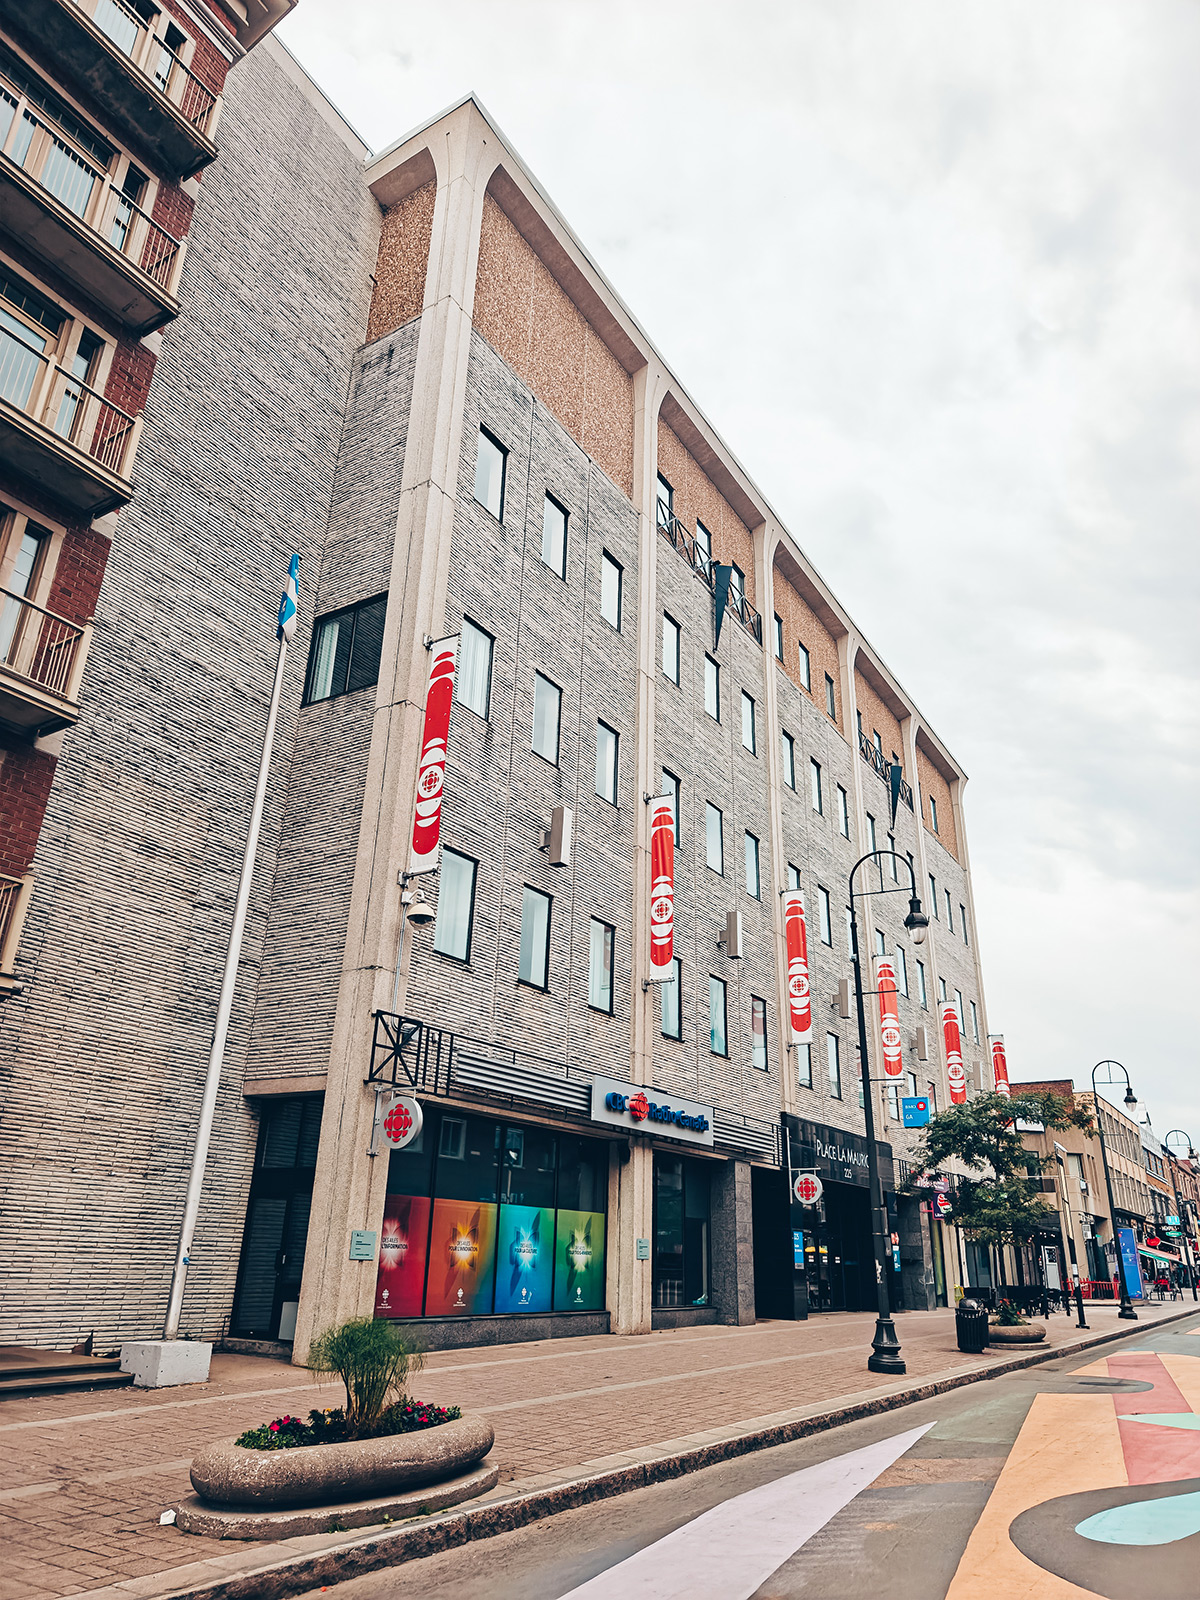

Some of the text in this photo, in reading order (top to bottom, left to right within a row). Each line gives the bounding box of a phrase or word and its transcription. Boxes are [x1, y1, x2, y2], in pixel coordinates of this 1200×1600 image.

[605, 1092, 630, 1112] CBC
[816, 1139, 870, 1168] PLACE LA MAURIC
[843, 1168, 853, 1179] 225
